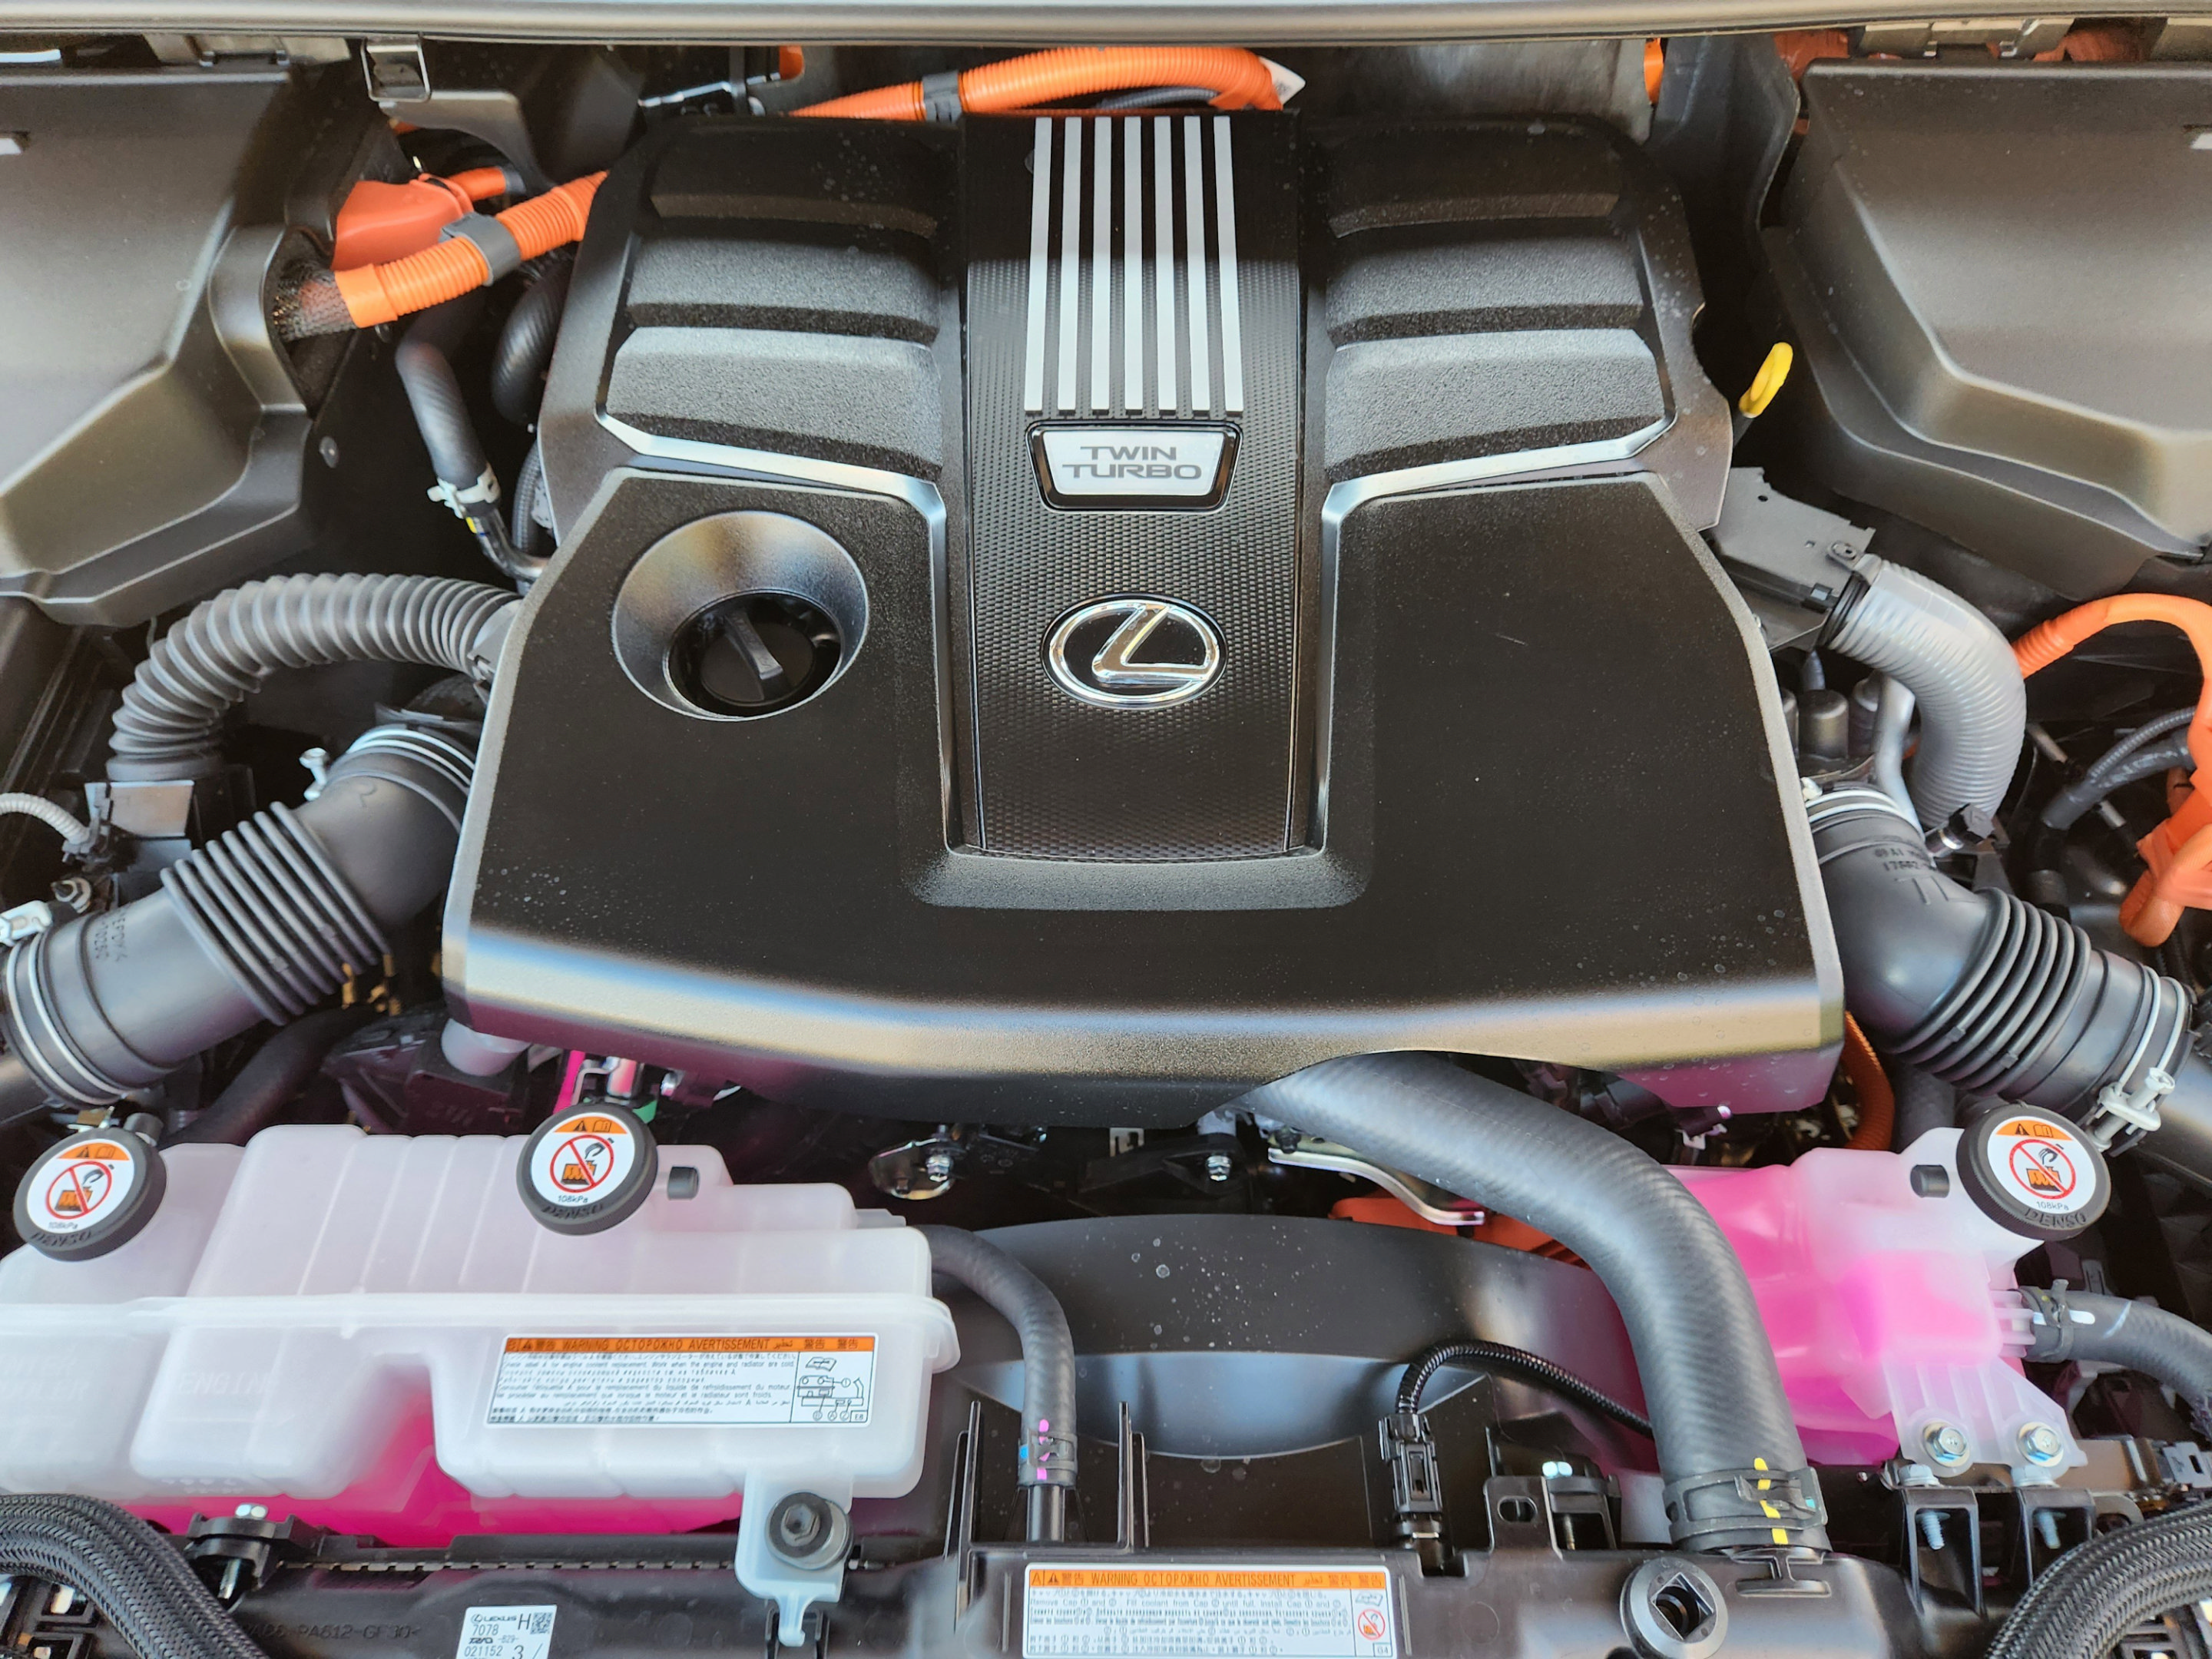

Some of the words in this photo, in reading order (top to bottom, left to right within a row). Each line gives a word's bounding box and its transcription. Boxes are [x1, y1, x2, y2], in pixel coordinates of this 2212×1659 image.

[1080, 446, 1177, 461] TWIN
[1062, 464, 1202, 480] TURBO
[558, 1194, 588, 1204] 108kPa
[2036, 1200, 2069, 1211] 108kPa
[2024, 1207, 2088, 1228] DENSO
[562, 1340, 610, 1350] WARNING
[688, 1339, 770, 1350] AVERTISSEMENT
[1091, 1572, 1137, 1585] WARNING
[1216, 1572, 1296, 1586] AVERTISSEMENT
[1194, 1599, 1208, 1608] Cap
[1223, 1599, 1238, 1608] until
[1286, 1600, 1302, 1608] Cap
[1316, 1600, 1330, 1608] and
[518, 1614, 531, 1630] H
[472, 1624, 499, 1636] 7078
[464, 1645, 503, 1657] 021152
[512, 1644, 524, 1659] 3
